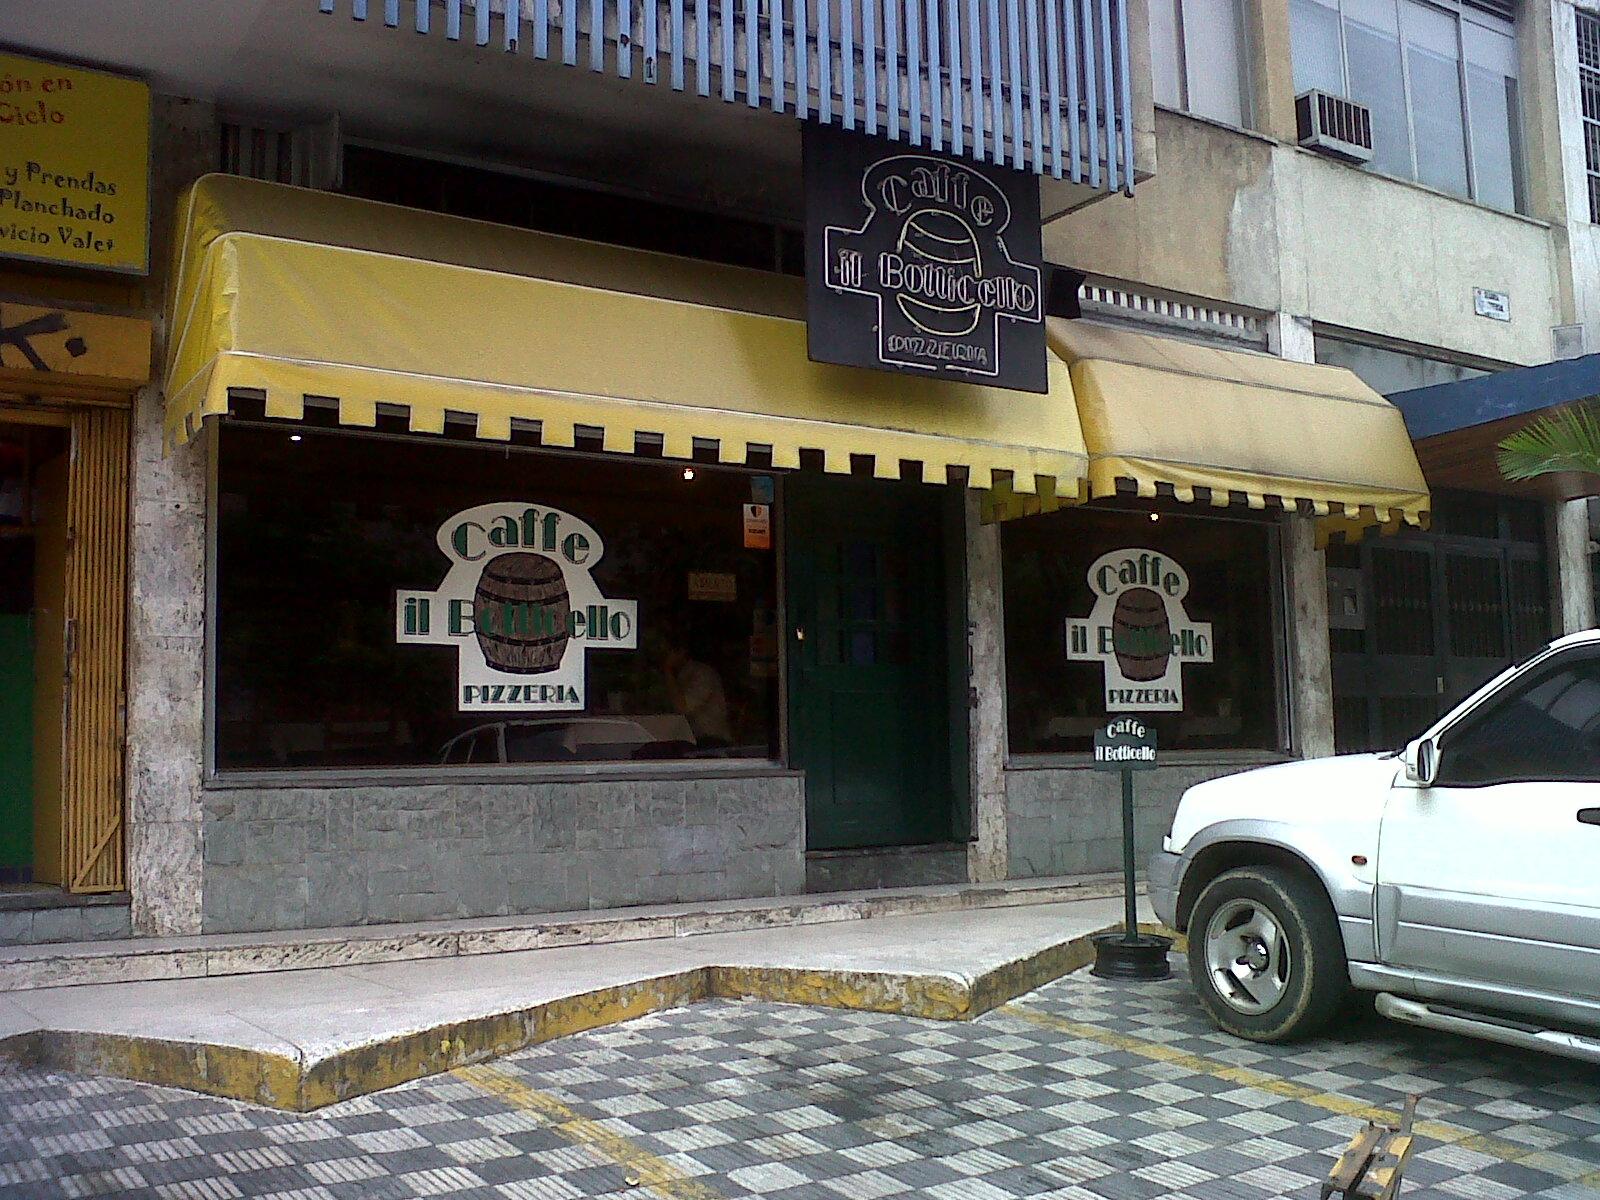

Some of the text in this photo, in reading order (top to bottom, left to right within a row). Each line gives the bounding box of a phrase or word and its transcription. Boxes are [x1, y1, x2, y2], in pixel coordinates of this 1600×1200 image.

[5, 160, 117, 196] y Prendas
[0, 187, 115, 224] Planchado
[57, 225, 116, 252] Valet
[451, 508, 590, 565] Caffe
[1096, 553, 1181, 598] Caffe
[403, 597, 431, 636] il
[1071, 624, 1088, 655] il
[462, 685, 580, 705] PIZZERIA
[1108, 689, 1179, 704] PIZZERIA
[1106, 718, 1147, 739] Caffe
